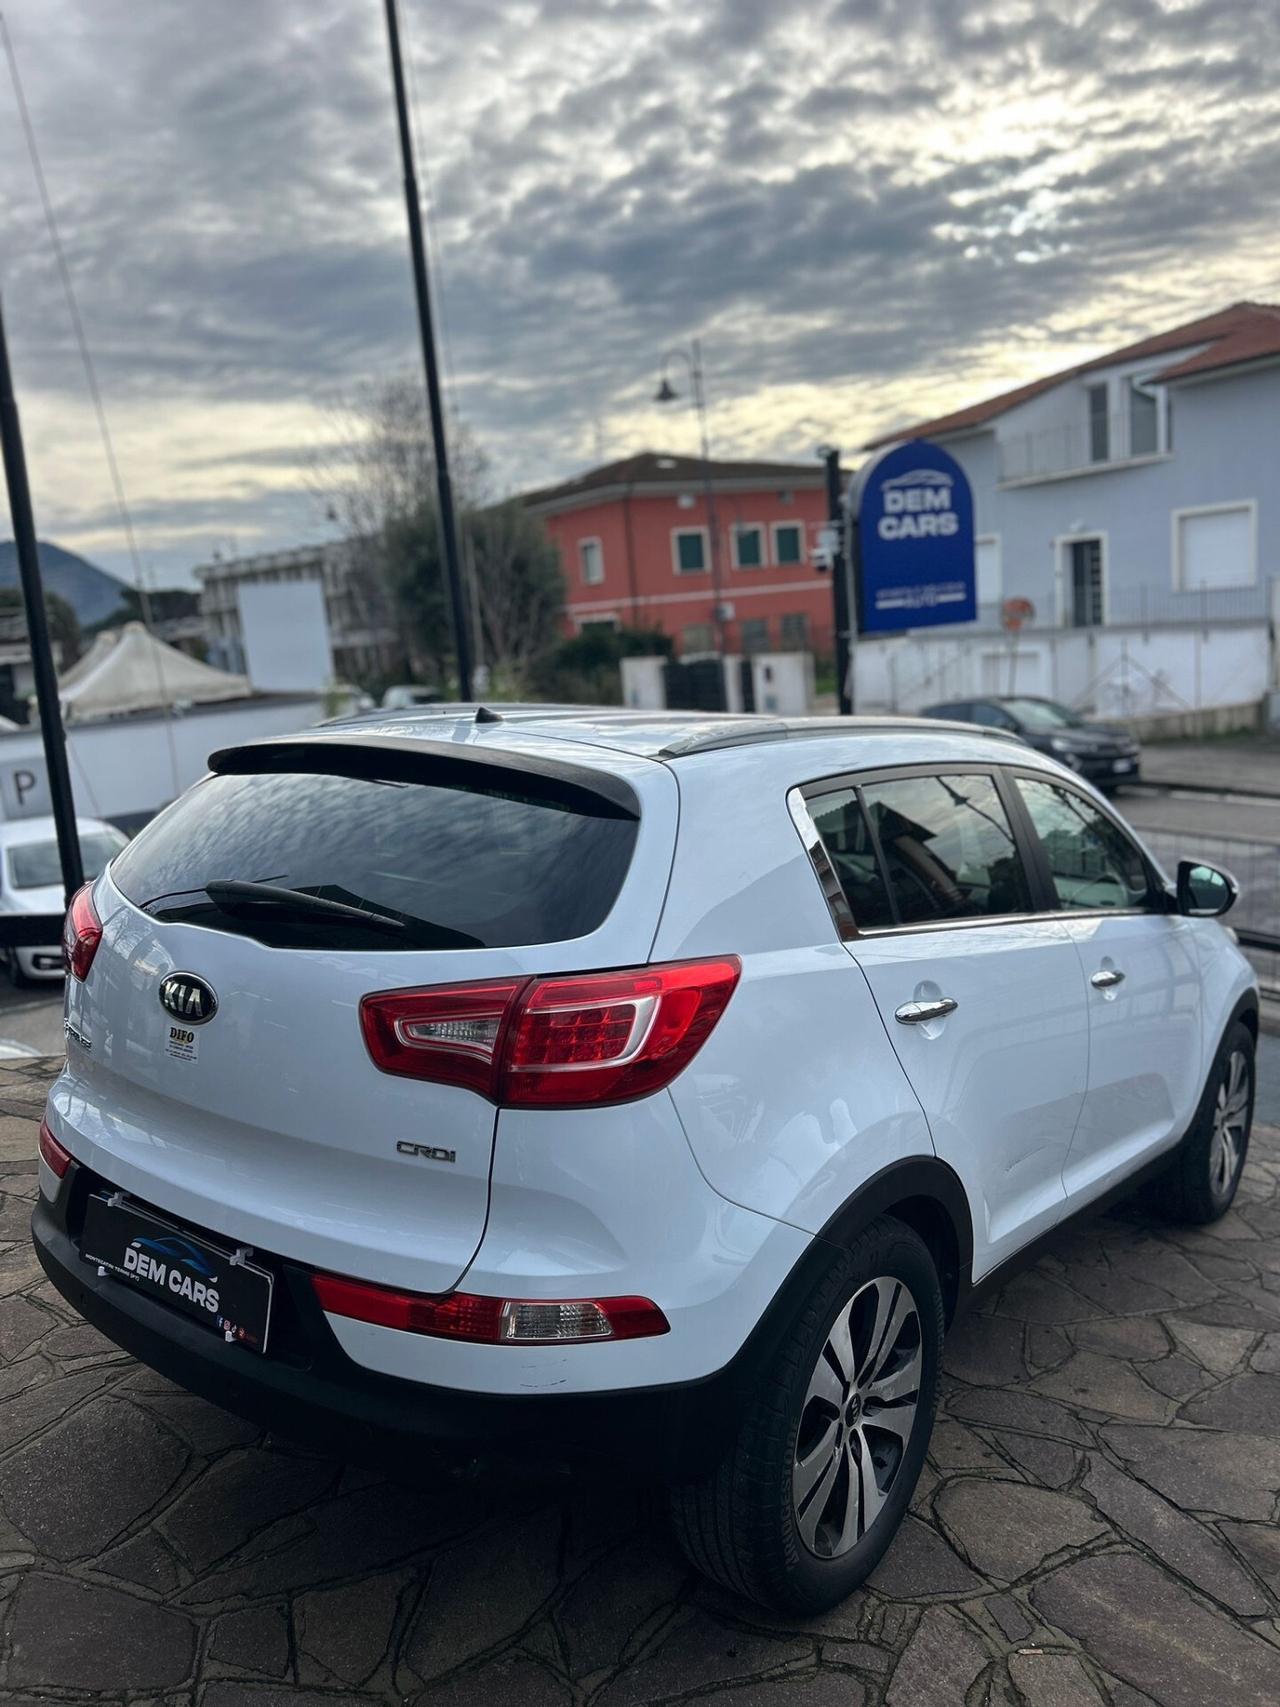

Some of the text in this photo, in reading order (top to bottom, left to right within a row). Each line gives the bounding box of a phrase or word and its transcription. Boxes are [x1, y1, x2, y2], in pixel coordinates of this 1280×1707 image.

[884, 488, 950, 513] DEM
[878, 512, 959, 540] CARS
[14, 770, 36, 805] P
[164, 981, 203, 1017] KIA
[124, 1248, 220, 1313] DEM CARS
